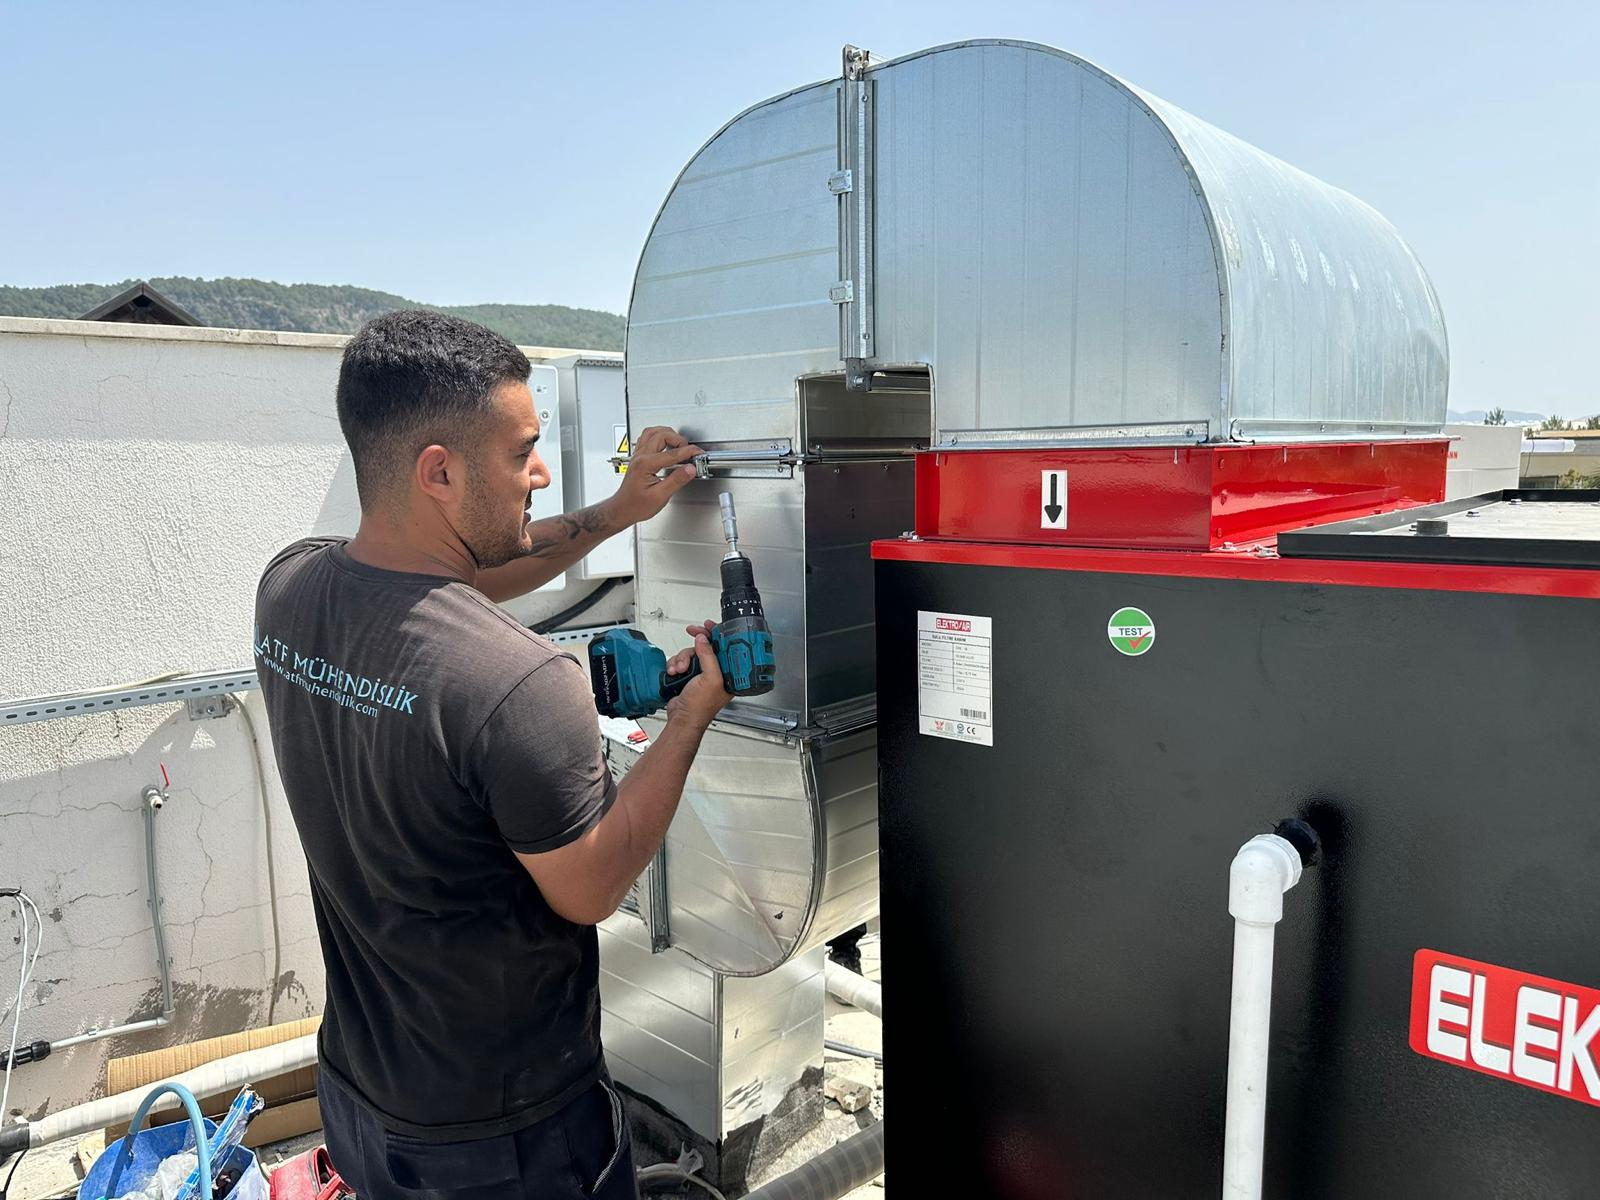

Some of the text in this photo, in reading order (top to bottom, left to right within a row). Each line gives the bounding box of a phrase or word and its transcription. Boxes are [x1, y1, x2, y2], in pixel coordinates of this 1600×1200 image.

[1118, 627, 1143, 636] TEST
[263, 656, 378, 718] www.atfmuhendlik.com
[294, 651, 419, 715] MÜHENDİSLİK
[1427, 964, 1600, 1101] ELEK
